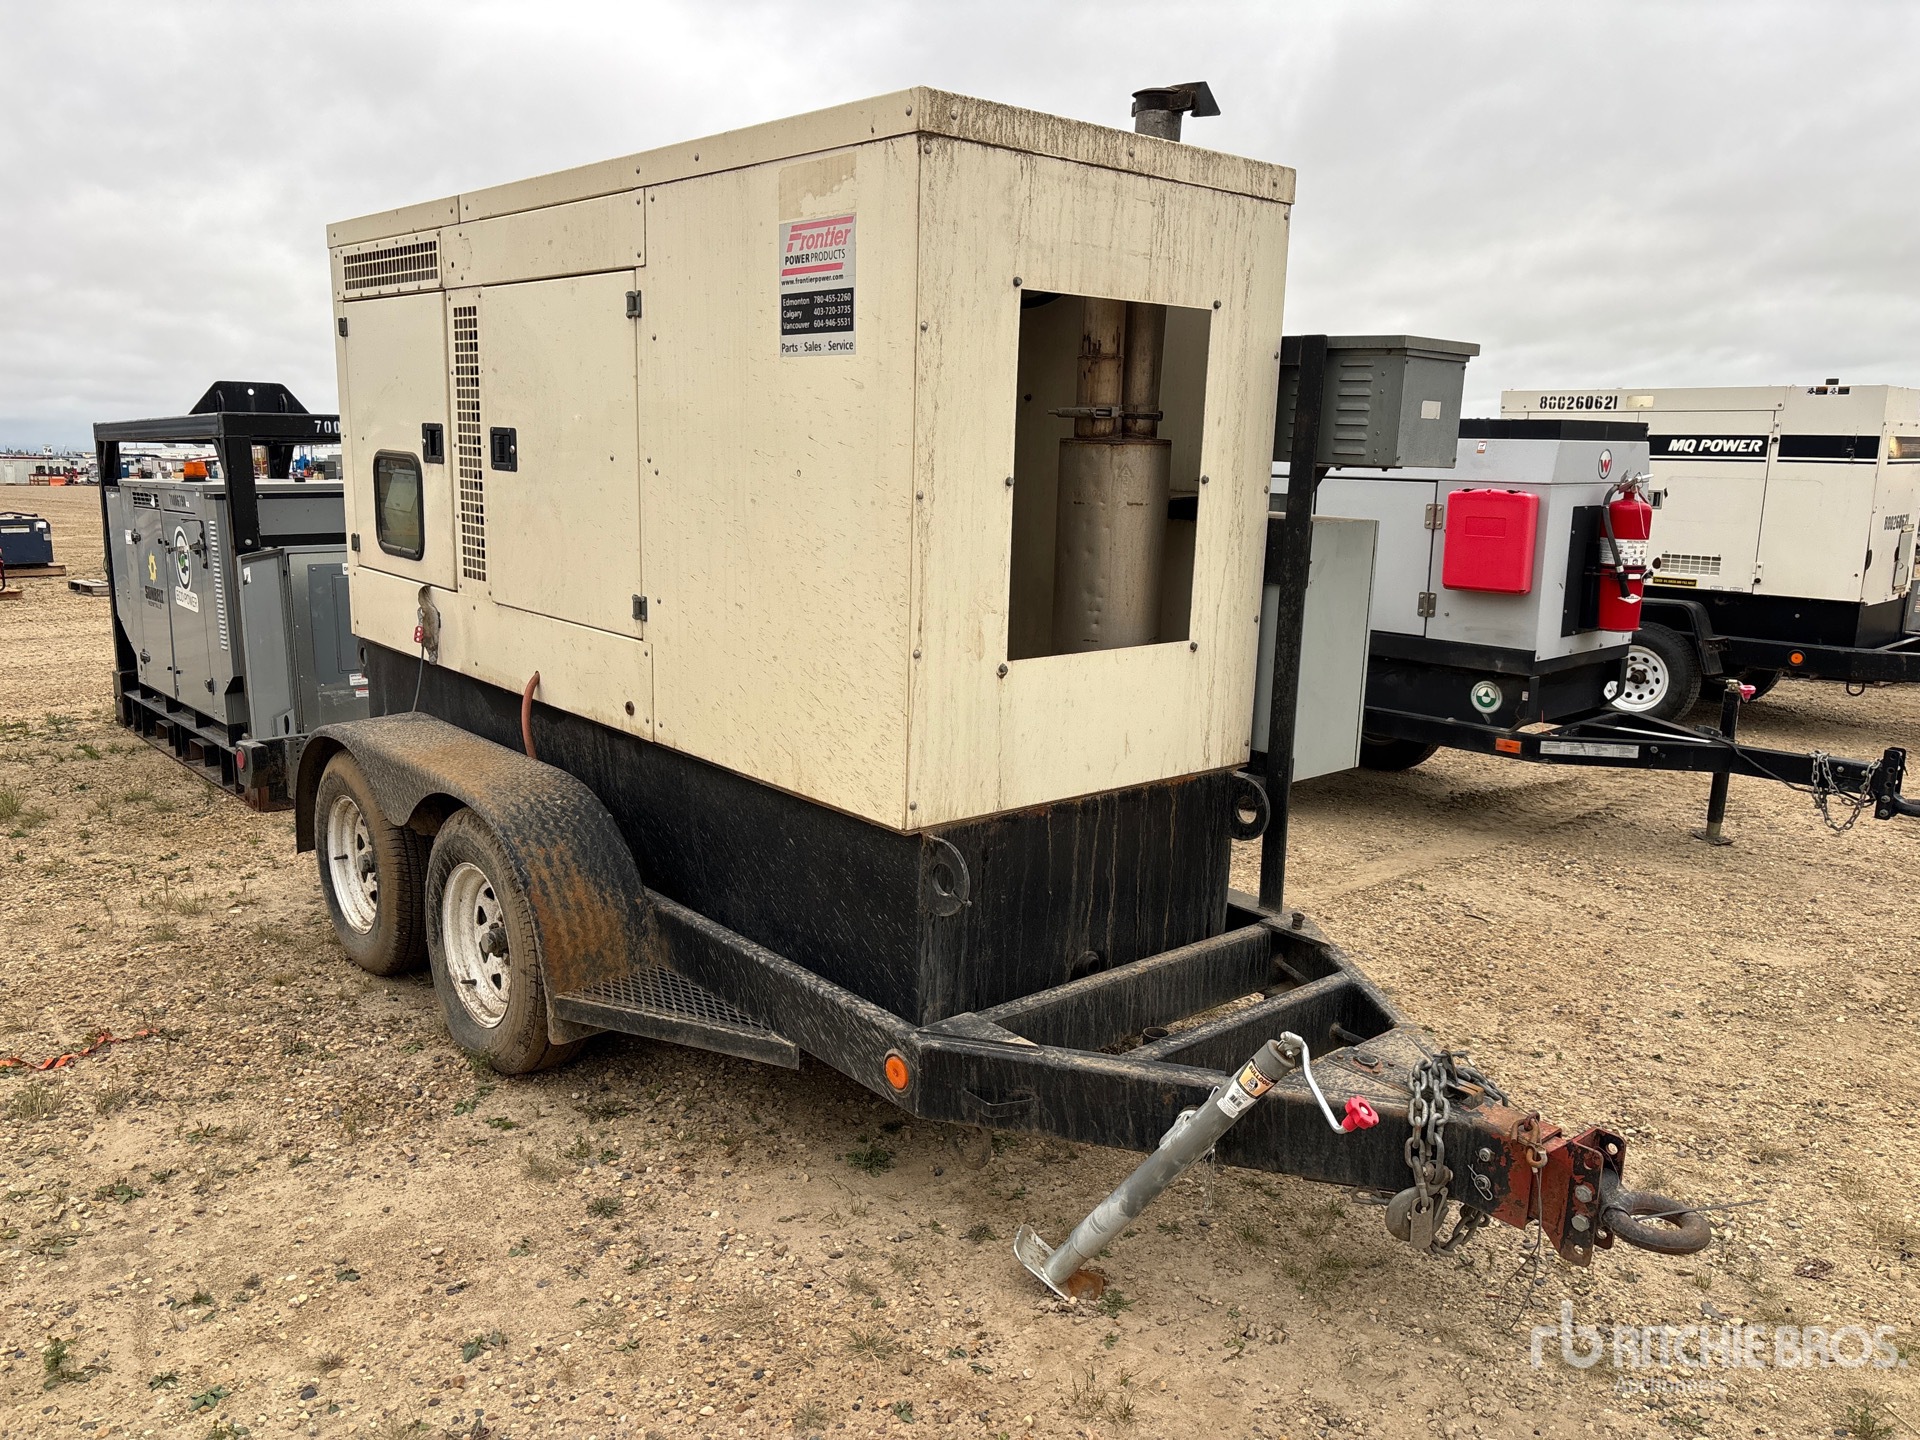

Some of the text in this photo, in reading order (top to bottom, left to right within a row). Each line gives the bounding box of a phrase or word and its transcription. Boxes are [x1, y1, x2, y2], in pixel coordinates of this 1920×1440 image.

[786, 226, 852, 253] Frontier
[781, 274, 844, 286] www.frontierpower.com
[782, 292, 852, 307] Edmonton 780-455-2260
[782, 305, 852, 320] Calgary 403-720-3735
[782, 317, 851, 330] Vancouver 604-946-5531
[781, 339, 854, 353] Parts Sales Service
[1539, 395, 1618, 410] 800260621
[1668, 438, 1764, 454] MQ POWER
[1248, 1064, 1271, 1087] BULLDOG
